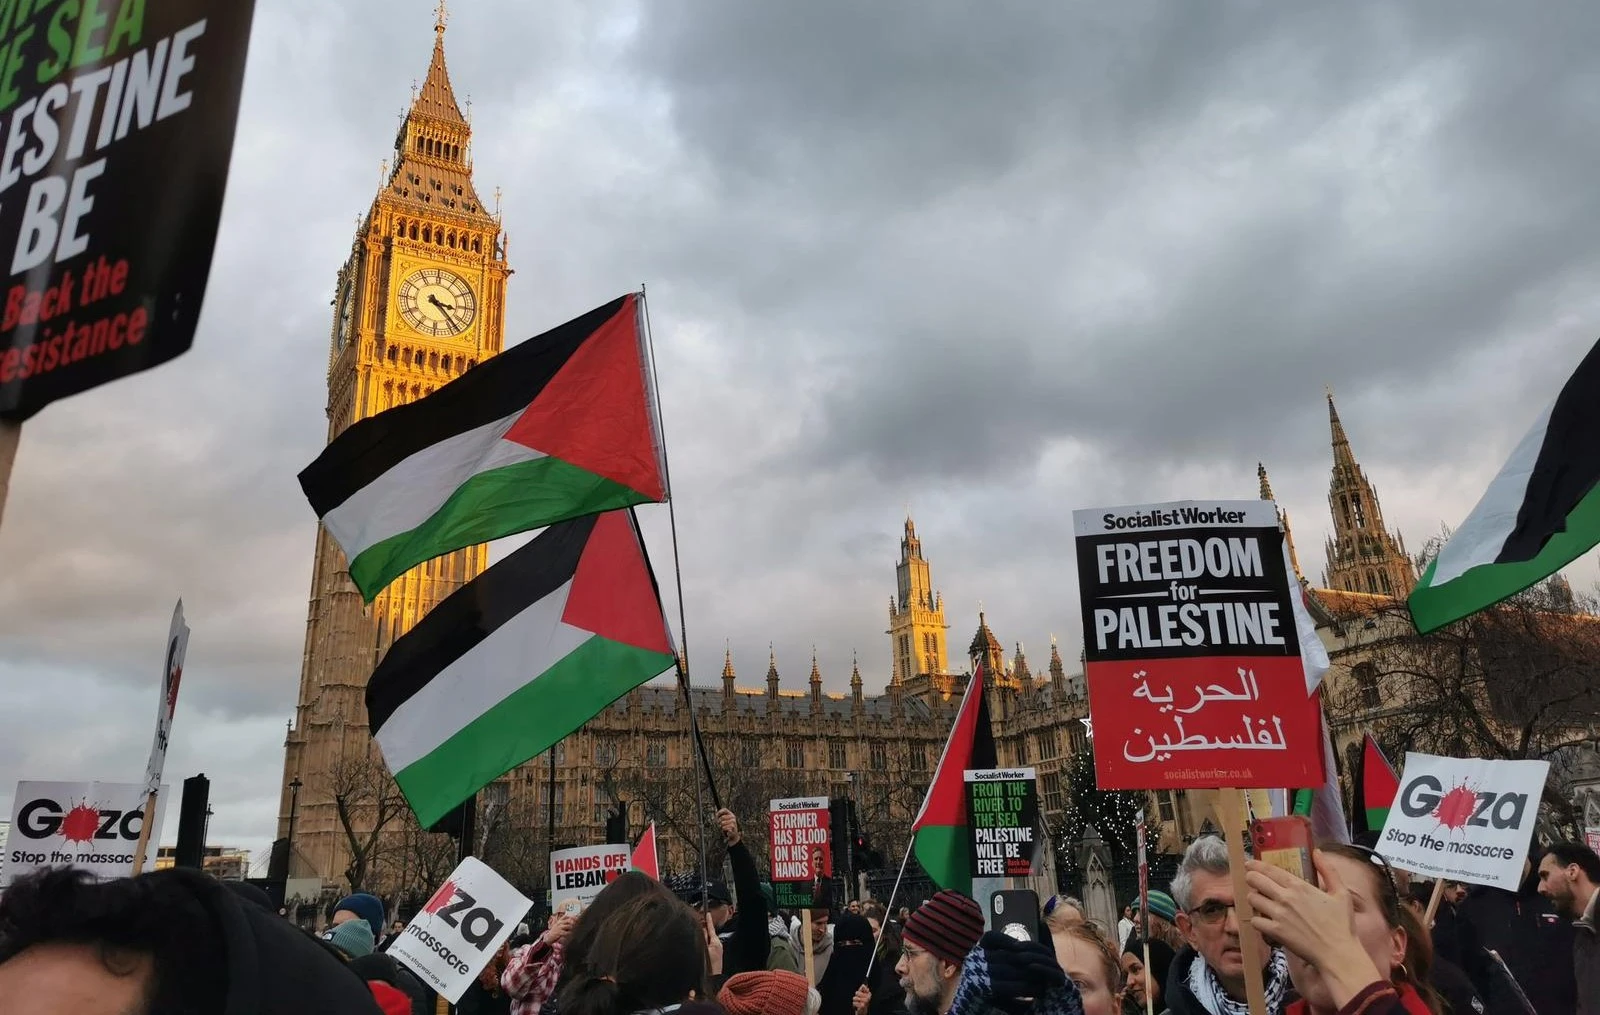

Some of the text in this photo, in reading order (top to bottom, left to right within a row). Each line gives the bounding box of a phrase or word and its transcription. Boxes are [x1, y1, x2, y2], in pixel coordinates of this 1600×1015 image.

[37, 0, 145, 83] SEA
[0, 19, 207, 193] ESTINE
[10, 157, 107, 276] BE
[1, 254, 129, 332] Back the
[1103, 507, 1246, 530] Socialist Worker
[1096, 537, 1264, 583] FREEDOM
[1170, 581, 1197, 601] for
[1094, 602, 1285, 650] PALESTINE
[1132, 666, 1259, 714] الحرية
[1123, 714, 1288, 763] لفلسطين
[974, 772, 1001, 780] Socialist
[1163, 767, 1253, 780] socialistworker.co.uk
[972, 781, 1028, 797] FROM THE
[974, 796, 1022, 812] RIVER TO
[773, 812, 818, 830] STARMER
[974, 812, 1019, 827] THE SEA
[774, 827, 827, 846] HAS BLOOD
[975, 827, 1033, 843] PALESTINE
[1386, 828, 1514, 860] Stop the massacre
[11, 850, 147, 865] Stop the massace
[775, 844, 809, 862] ON HIS
[976, 842, 1020, 859] WILL BE
[555, 853, 627, 874] HANDS OFF
[775, 860, 809, 878] HANDS
[977, 859, 1004, 875] FREE
[775, 883, 793, 895] FREE
[776, 894, 813, 906] PALESTINE
[407, 924, 469, 975] massacre
